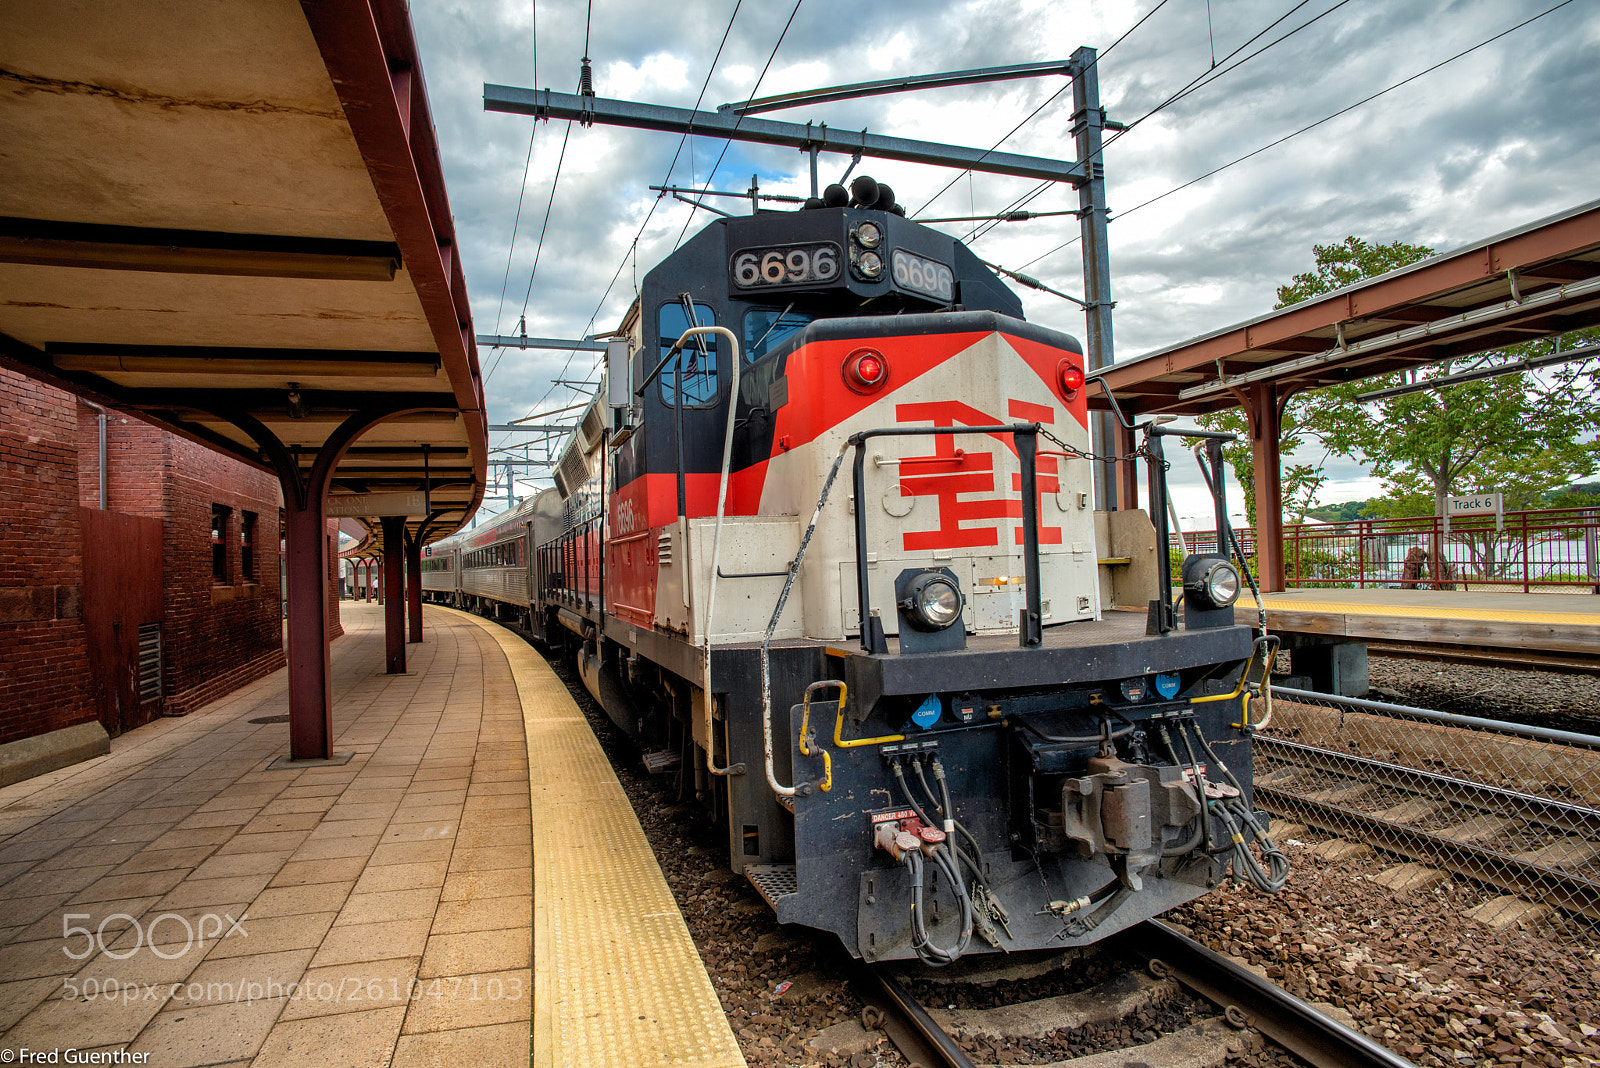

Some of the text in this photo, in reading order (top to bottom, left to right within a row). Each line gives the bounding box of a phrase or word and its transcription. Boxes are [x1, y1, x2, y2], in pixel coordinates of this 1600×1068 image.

[735, 248, 837, 286] 6696
[893, 252, 952, 296] 6696
[617, 498, 635, 534] 6696
[1453, 497, 1492, 510] Track 6
[873, 811, 896, 822] DANGER
